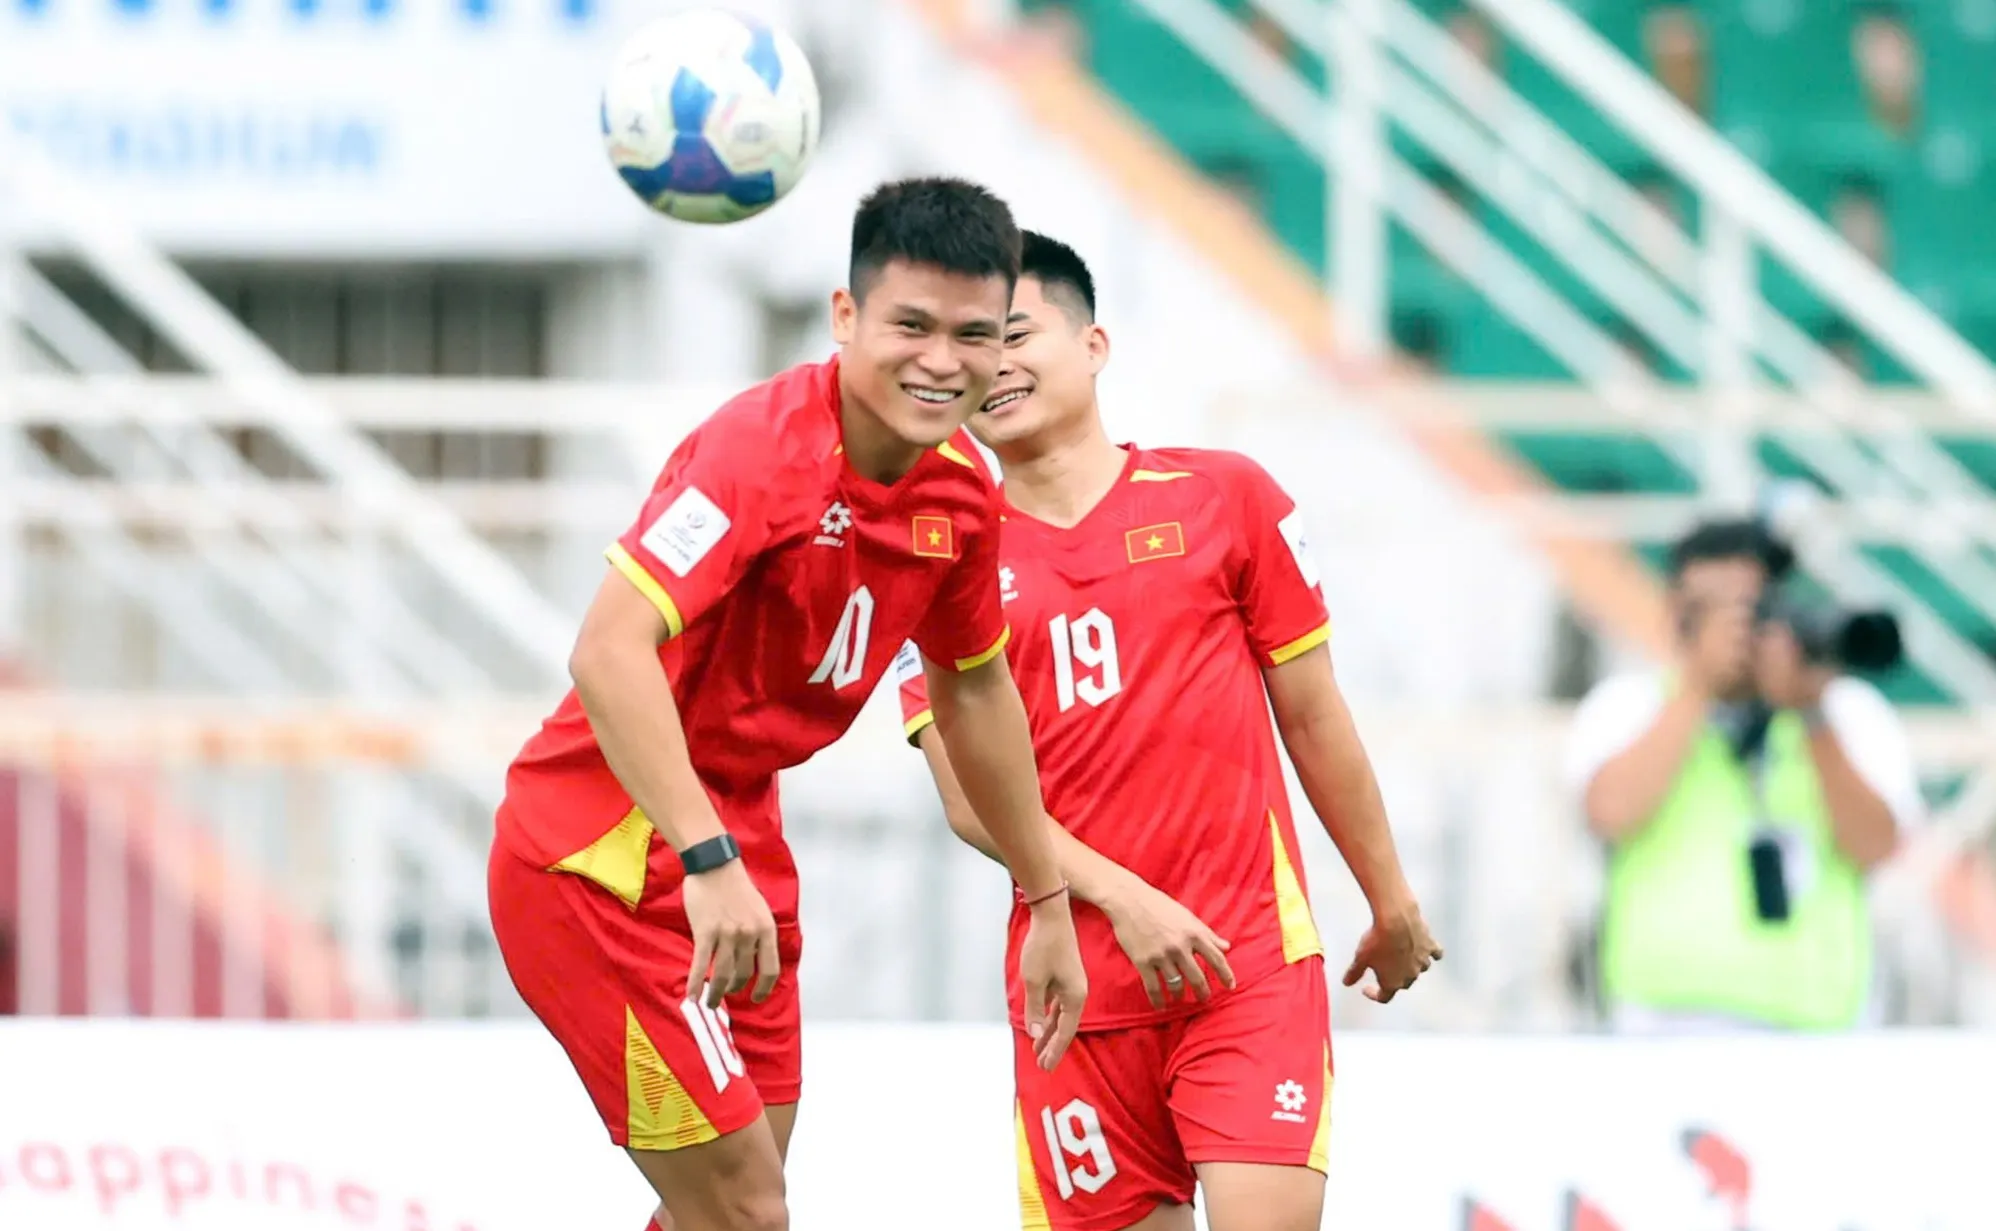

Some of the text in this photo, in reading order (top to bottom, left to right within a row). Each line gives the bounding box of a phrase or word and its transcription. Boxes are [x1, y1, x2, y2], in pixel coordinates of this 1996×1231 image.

[807, 584, 875, 691] 10
[1048, 607, 1122, 713] 19
[1040, 1098, 1118, 1200] 19
